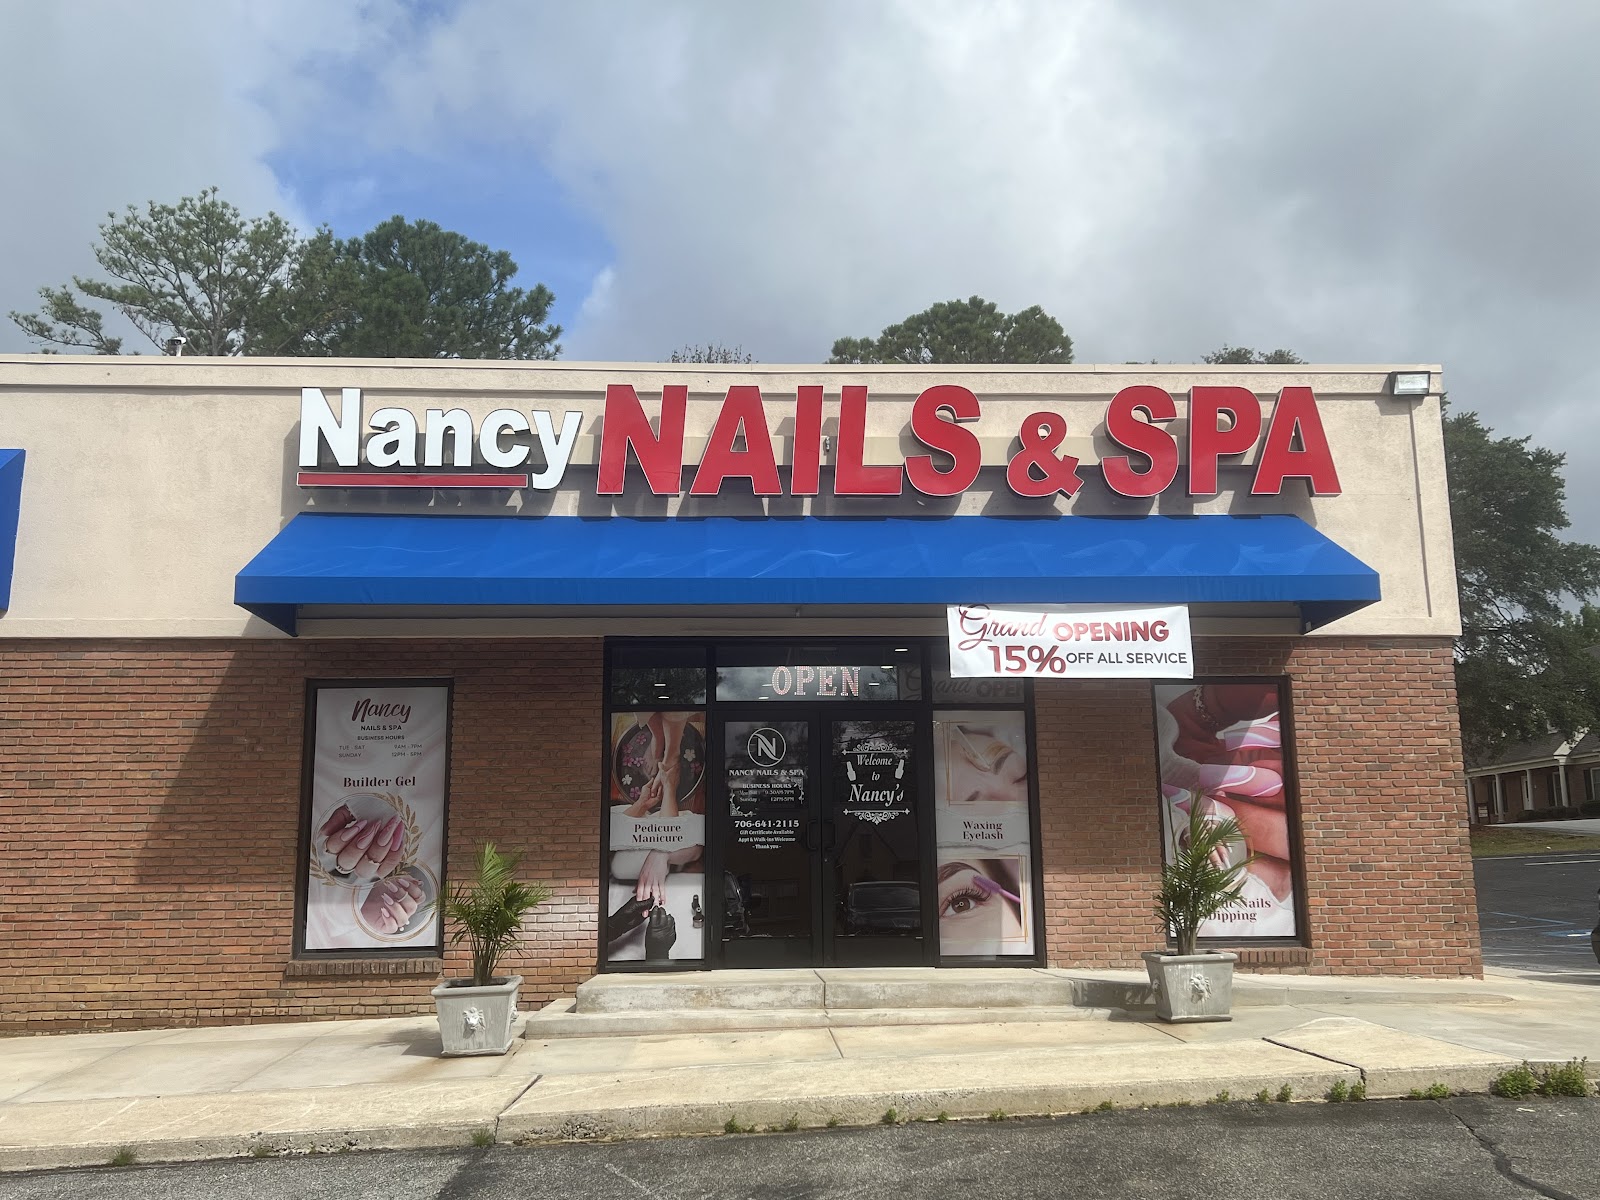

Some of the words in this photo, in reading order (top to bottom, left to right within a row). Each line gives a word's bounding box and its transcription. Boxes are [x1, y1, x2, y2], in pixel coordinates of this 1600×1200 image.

[299, 387, 583, 490] Nancy
[596, 384, 981, 498] NAILS
[1006, 411, 1085, 500] &
[1101, 385, 1342, 498] SPA
[958, 603, 1048, 650] Grand
[1052, 620, 1169, 642] OPENING
[987, 645, 1066, 674] 15%
[1066, 652, 1094, 664] OFF
[1097, 652, 1123, 664] ALL
[1126, 652, 1187, 664] SERVICE
[772, 666, 860, 696] OPEN
[351, 698, 411, 723] Nancy
[754, 733, 782, 760] N
[857, 753, 892, 765] Welcome
[872, 771, 880, 780] to
[343, 776, 392, 788] Builder
[395, 776, 416, 787] Gel
[848, 783, 904, 807] Nancy's
[634, 824, 681, 833] Pedicure
[734, 820, 799, 828] 706-641-2115
[963, 821, 1003, 830] Waxing
[632, 834, 683, 843] Manicure
[963, 831, 1003, 841] Eyelash
[1208, 910, 1257, 923] Dipping
